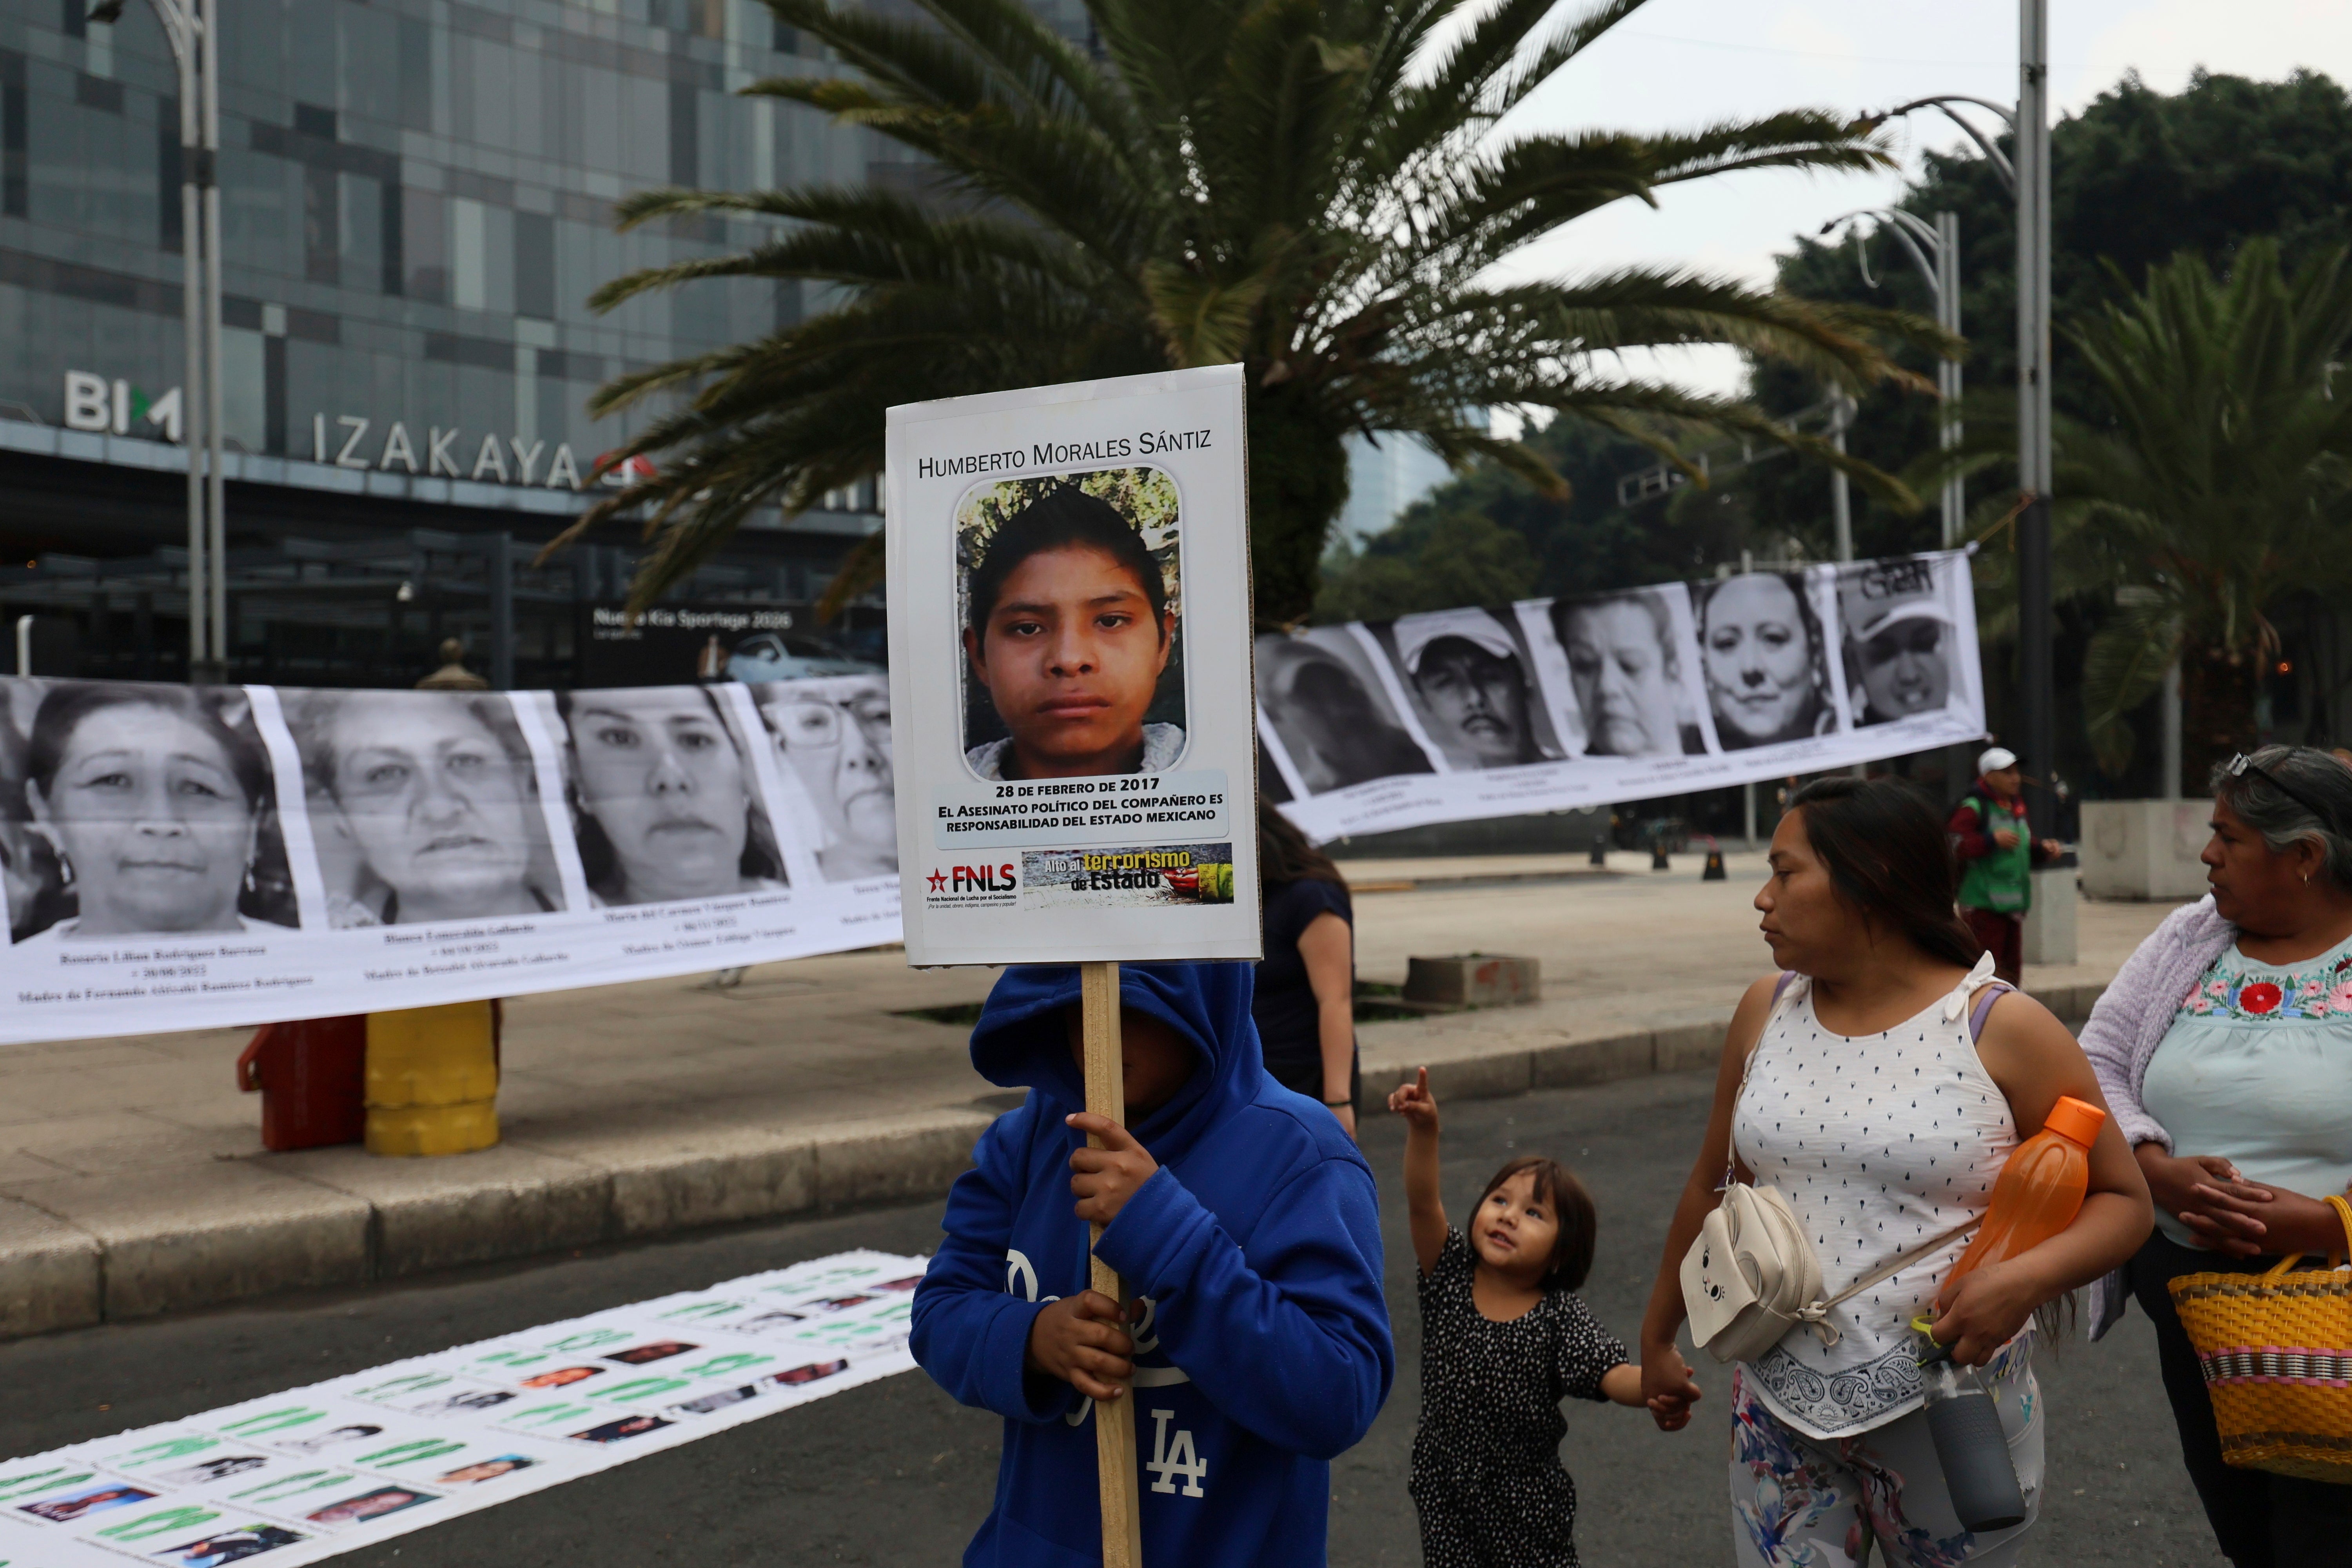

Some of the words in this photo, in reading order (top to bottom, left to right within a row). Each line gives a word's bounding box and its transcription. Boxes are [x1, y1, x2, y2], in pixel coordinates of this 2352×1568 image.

[314, 412, 583, 490] IZAKAYA
[918, 450, 1025, 479] HUMBERTO
[1034, 437, 1131, 465] MORALES
[1139, 430, 1211, 454] SÁNTIZ
[593, 608, 646, 626] Nuea
[648, 608, 676, 626] Kia
[677, 609, 749, 630] Sportage
[996, 786, 1014, 798] 28
[1018, 787, 1034, 796] DE
[1038, 784, 1094, 796] FEBRERO
[1099, 783, 1116, 792] DE
[1120, 778, 1159, 791] 2017
[938, 807, 954, 818] EL
[957, 804, 1028, 817] ASESINATO
[1031, 800, 1089, 813] POLÍTICO
[1093, 800, 1118, 810] DEL
[1121, 794, 1206, 809] COMPAÑERO
[1209, 794, 1223, 804] ES
[947, 818, 1059, 832] RESPONSABILIDAD
[1063, 816, 1086, 826] DEL
[1090, 813, 1142, 825] ESTADO
[1146, 810, 1215, 822] MEXICANO
[1045, 860, 1067, 872] Alto
[1070, 859, 1080, 871] al
[1083, 850, 1190, 871] terrorismo
[953, 864, 1016, 893] FNLS
[1071, 878, 1087, 891] de
[1091, 869, 1159, 890] Estado
[1147, 1409, 1207, 1497] LA
